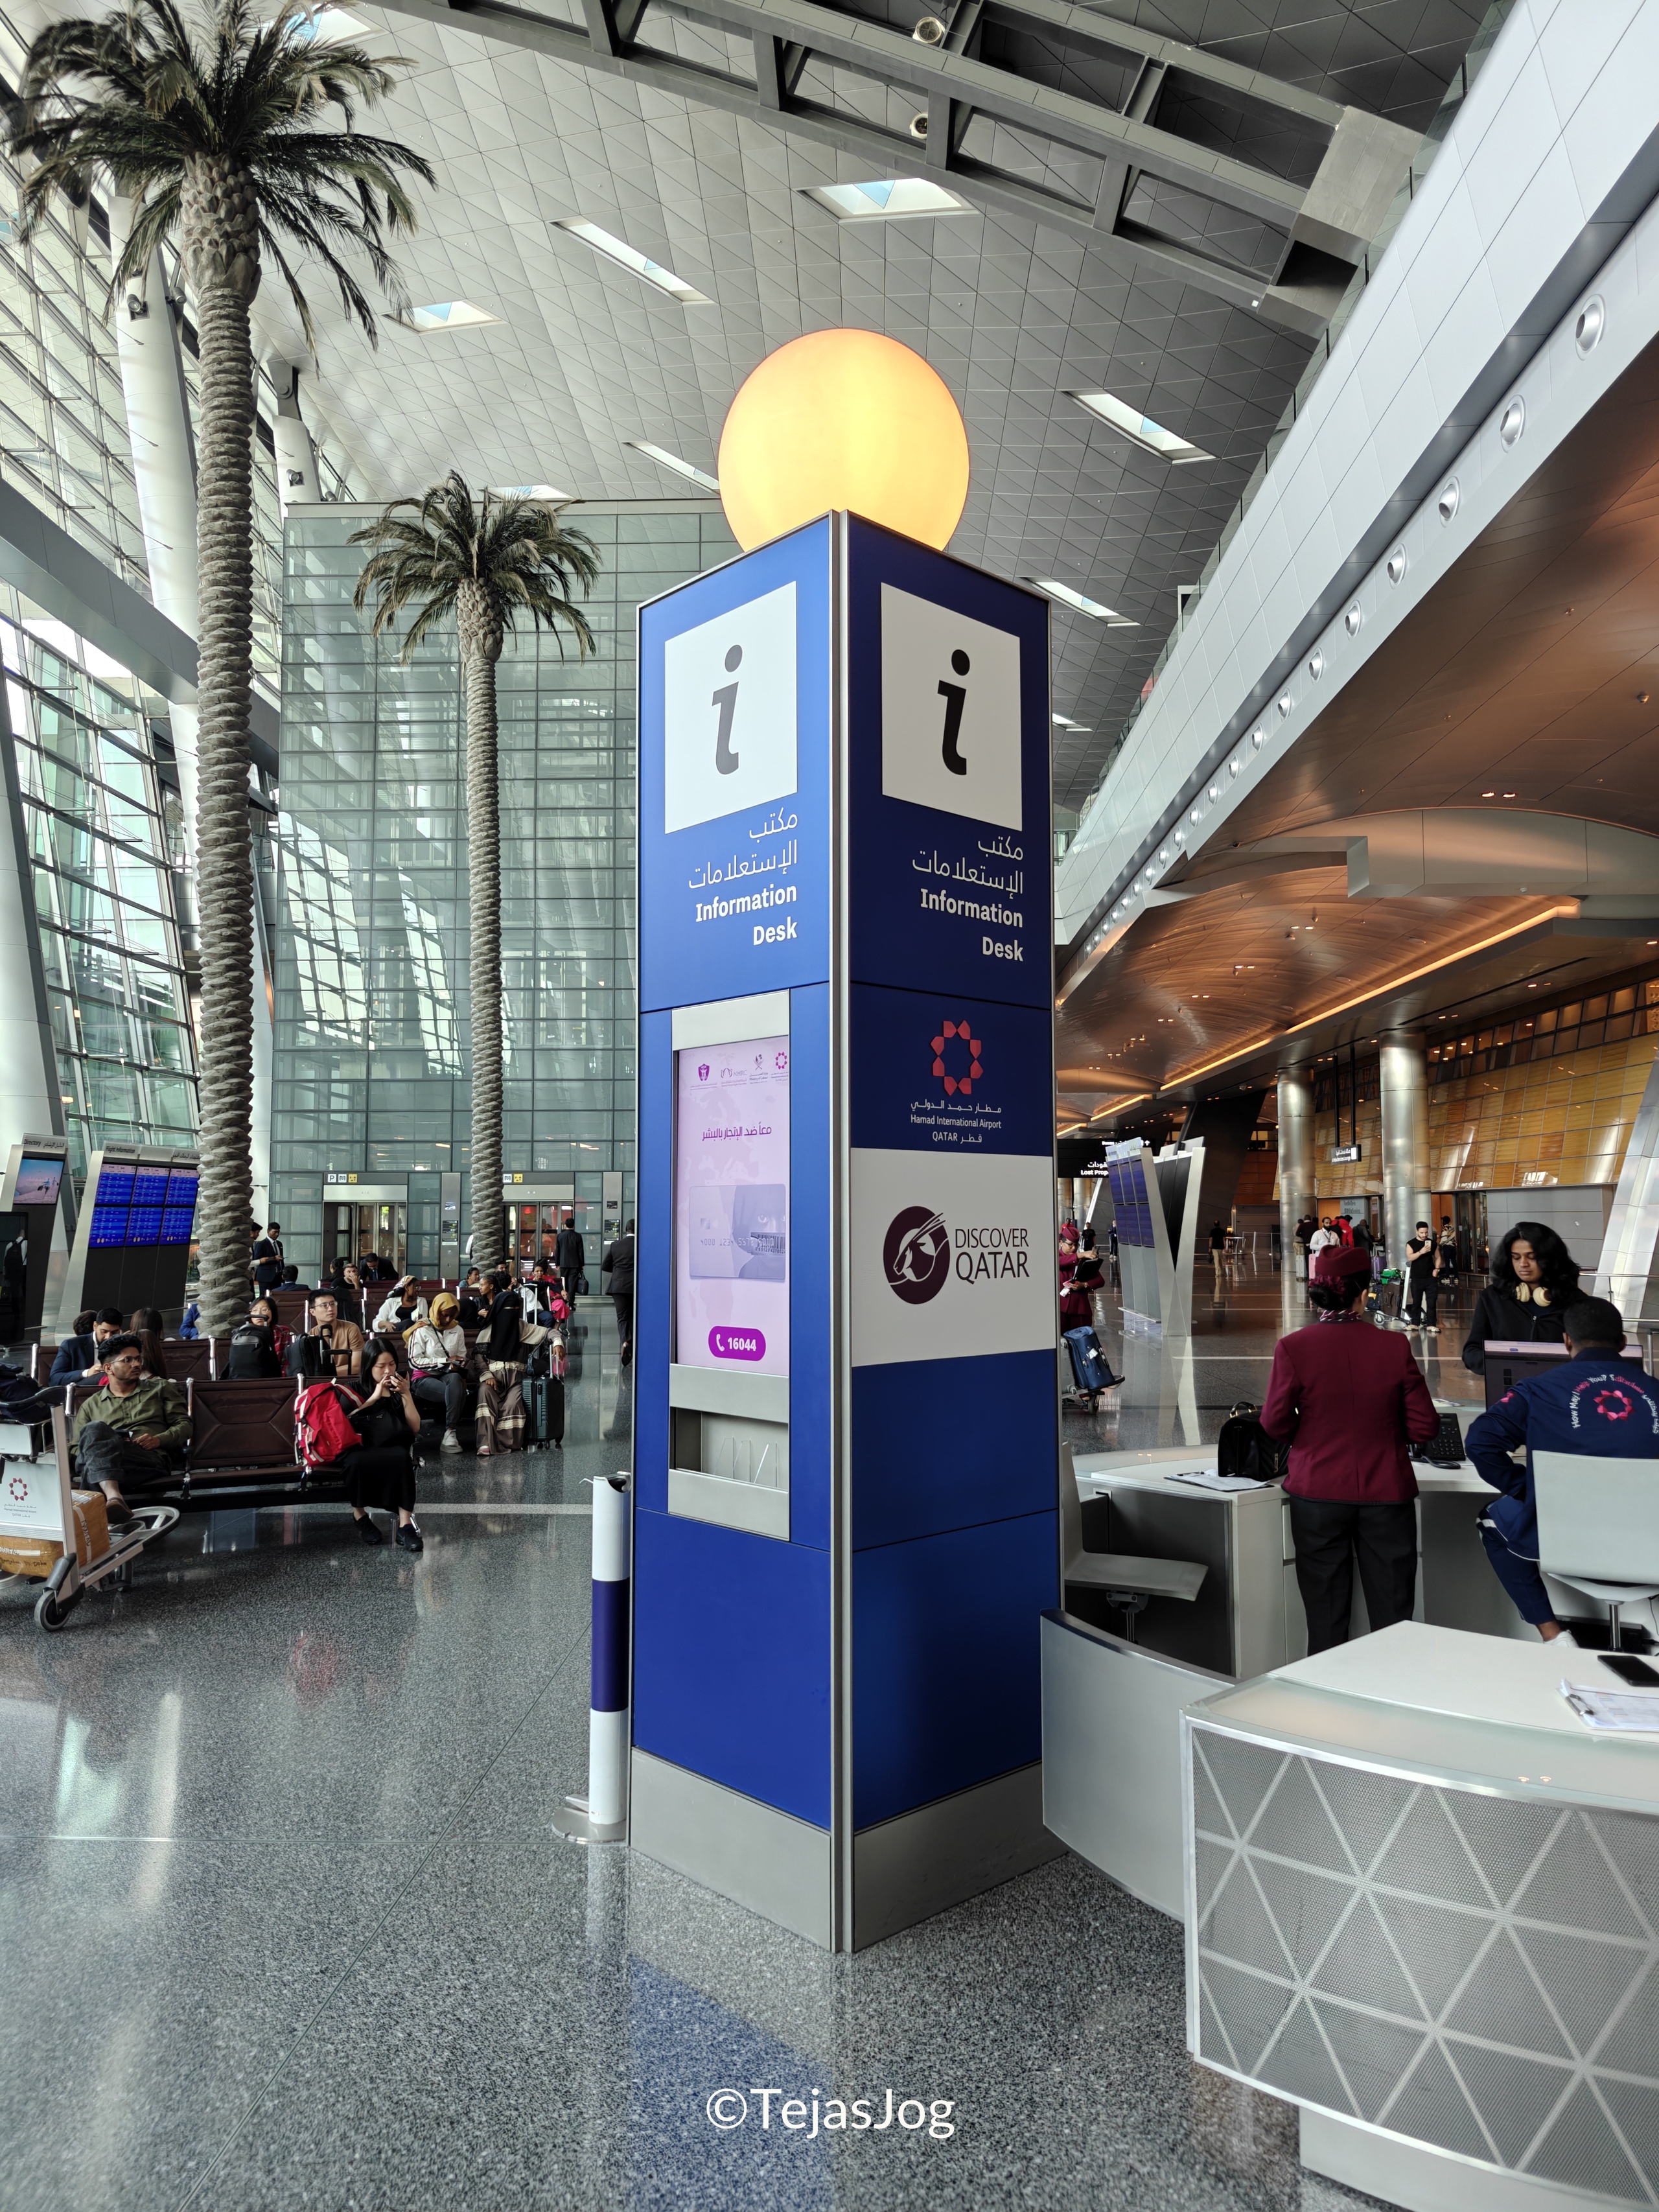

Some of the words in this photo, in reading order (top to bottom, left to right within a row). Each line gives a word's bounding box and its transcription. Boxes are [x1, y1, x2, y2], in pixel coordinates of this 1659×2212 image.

[749, 807, 798, 843] مكتب
[977, 835, 1024, 861] مكتب
[688, 839, 798, 889] الإستعلامات
[912, 850, 1023, 900] الإستعلامات
[695, 883, 797, 922] Information
[920, 888, 1023, 928] Information
[752, 916, 798, 946] Desk
[982, 936, 1024, 962] Desk
[911, 1099, 944, 1112] الدولي
[947, 1103, 973, 1112] حمد
[975, 1102, 1002, 1114] مطار
[744, 1126, 758, 1136] ضد
[911, 1113, 935, 1124] Hamad
[936, 1115, 979, 1127] International
[979, 1119, 1002, 1130] Airport
[702, 1128, 723, 1141] بالبشر
[932, 1131, 958, 1142] QATAR
[960, 1134, 982, 1144] قطر
[955, 1228, 1029, 1249] DISCOVER
[956, 1250, 1030, 1285] QATAR
[727, 1337, 757, 1351] 16044
[1569, 1394, 1581, 1410] May
[1571, 1410, 1581, 1429] How
